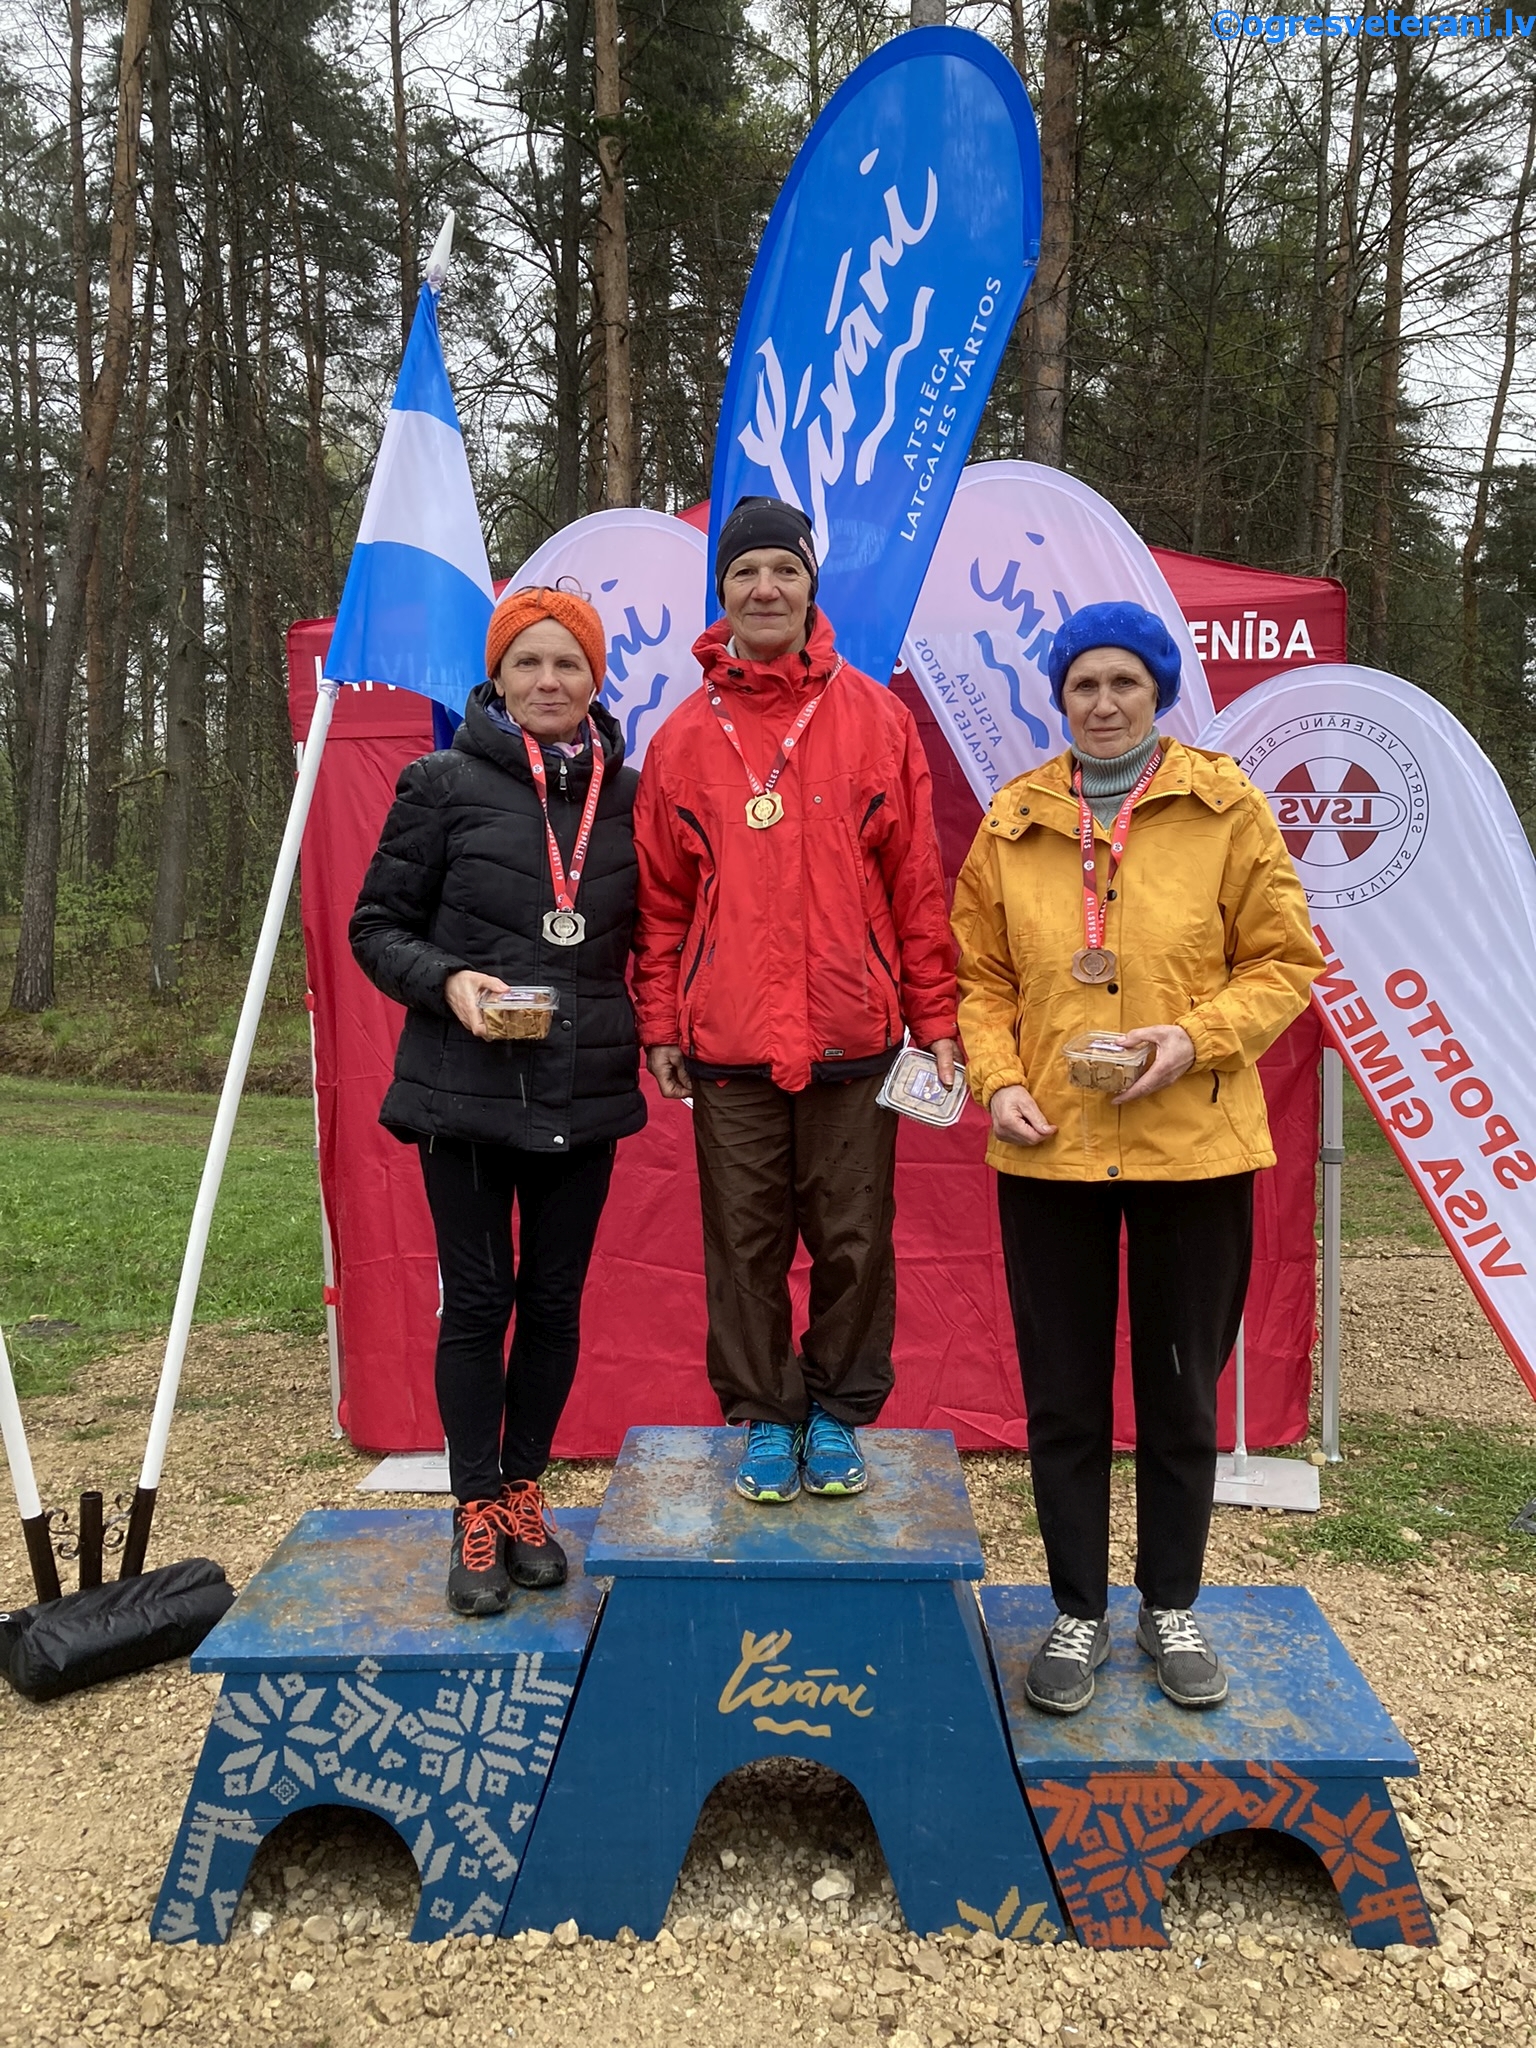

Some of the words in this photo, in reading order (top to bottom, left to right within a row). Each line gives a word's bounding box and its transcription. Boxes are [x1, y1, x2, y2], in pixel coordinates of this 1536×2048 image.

[900, 405, 957, 542] LATGALES
[950, 276, 1002, 393] VĀRTOS
[903, 347, 954, 471] ATSLĒGA
[1188, 611, 1316, 660] ENĪBA
[589, 778, 600, 798] LSVS
[581, 799, 596, 829] SPORTA
[1082, 818, 1092, 848] SPĒLES
[1085, 910, 1096, 931] LSVS
[718, 1628, 877, 1718] Līvāni
